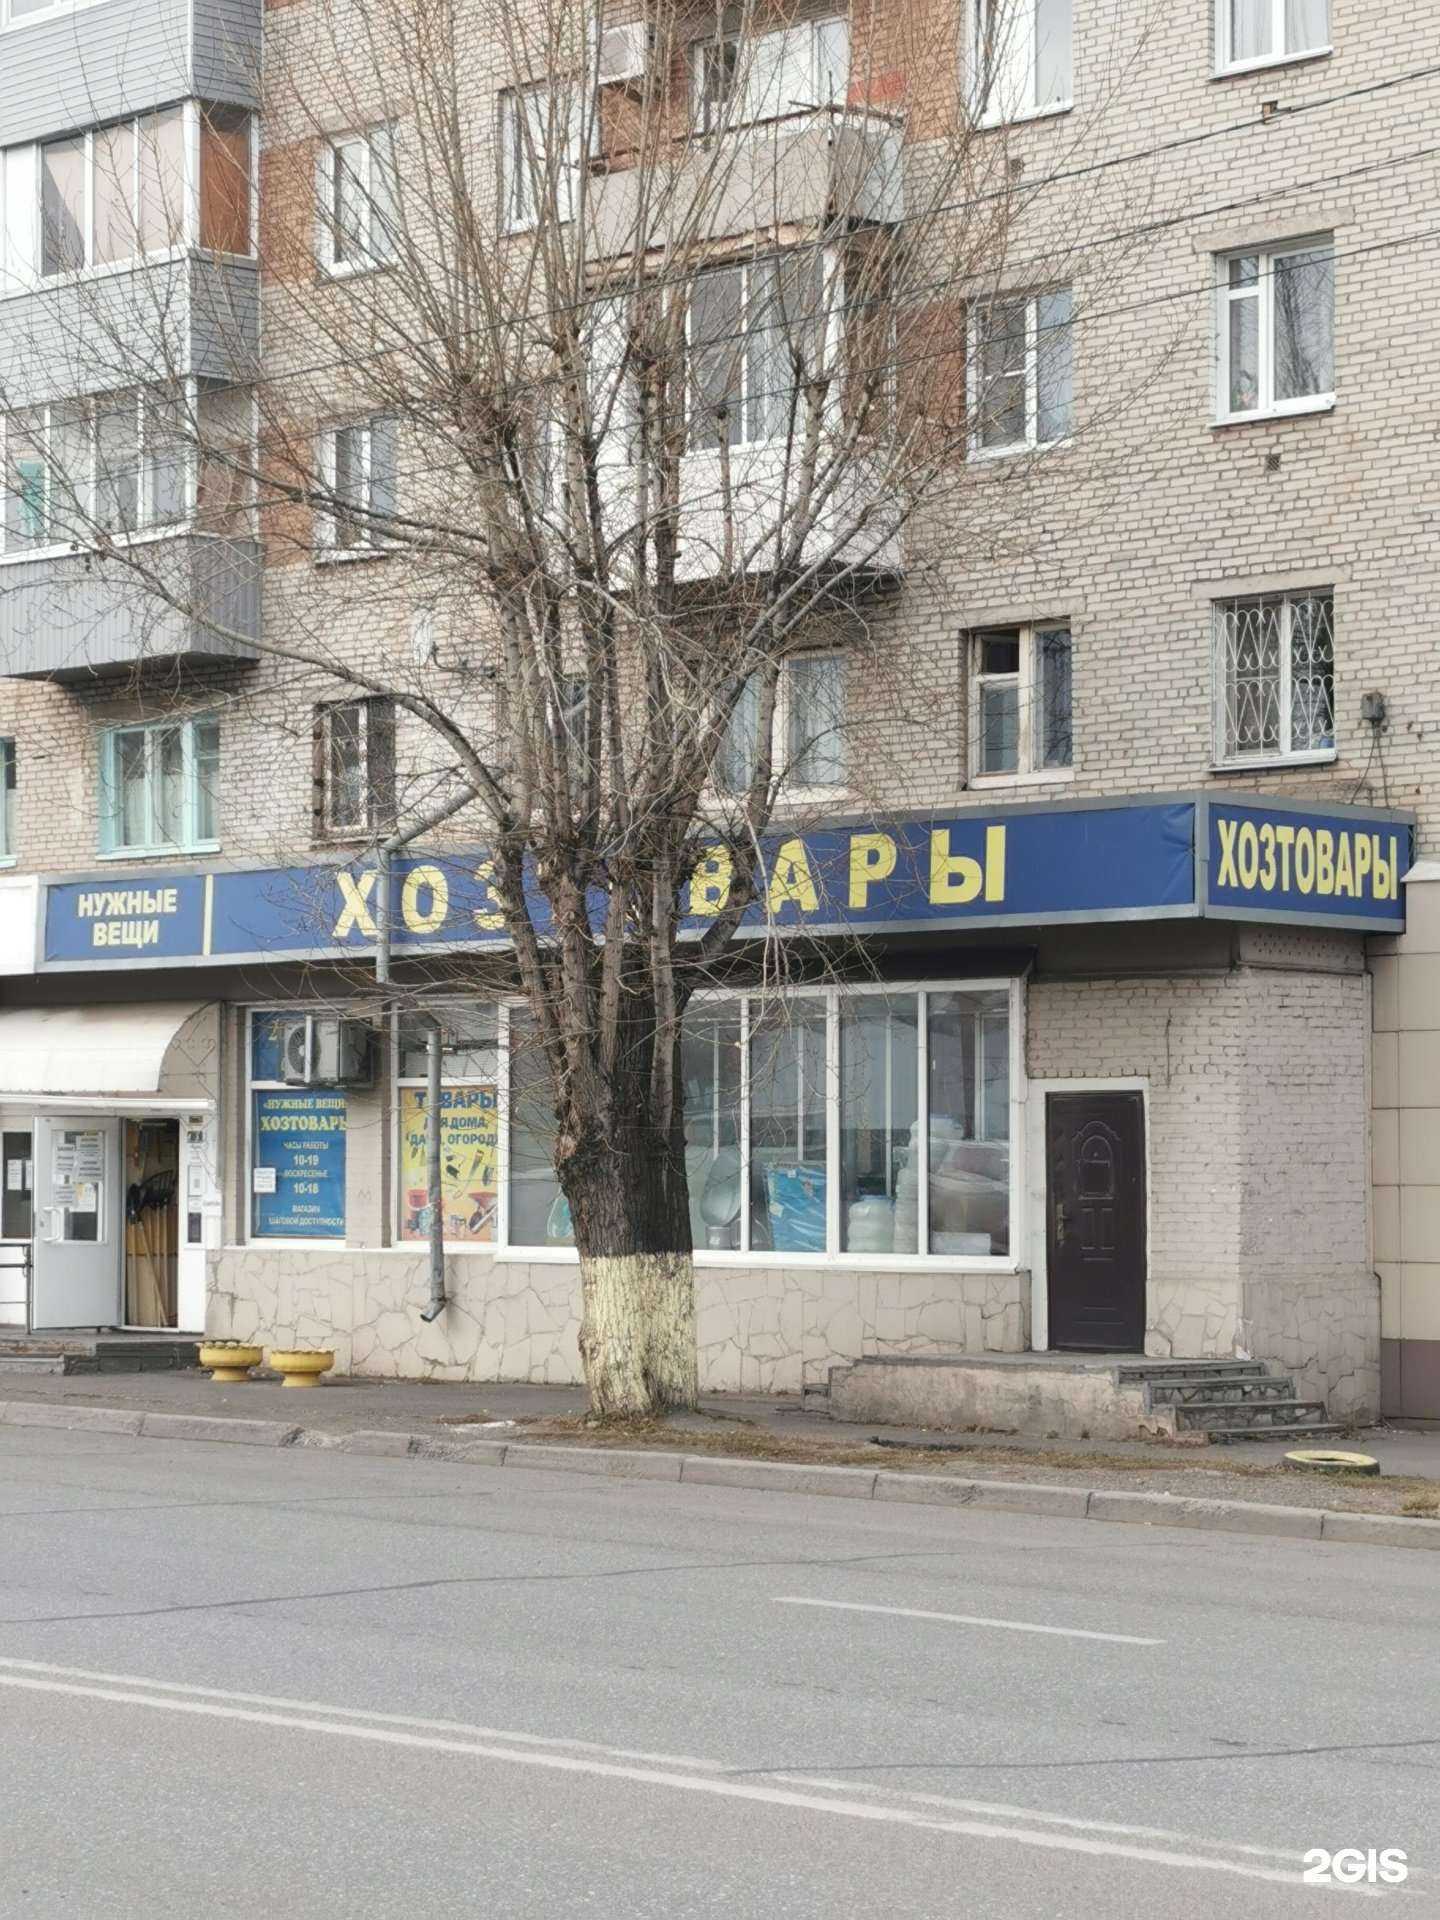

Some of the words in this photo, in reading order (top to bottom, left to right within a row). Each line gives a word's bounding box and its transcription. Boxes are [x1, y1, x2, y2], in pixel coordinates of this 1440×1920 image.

[1217, 819, 1397, 900] ХОЗТОВАРЫ
[331, 825, 1007, 938] ХОЗВАРЫ
[78, 888, 178, 917] НУЖНЫЕ
[93, 920, 160, 948] ВЕЩИ
[415, 1091, 497, 1109] ТВАРЫ
[293, 1154, 320, 1166] 10-19
